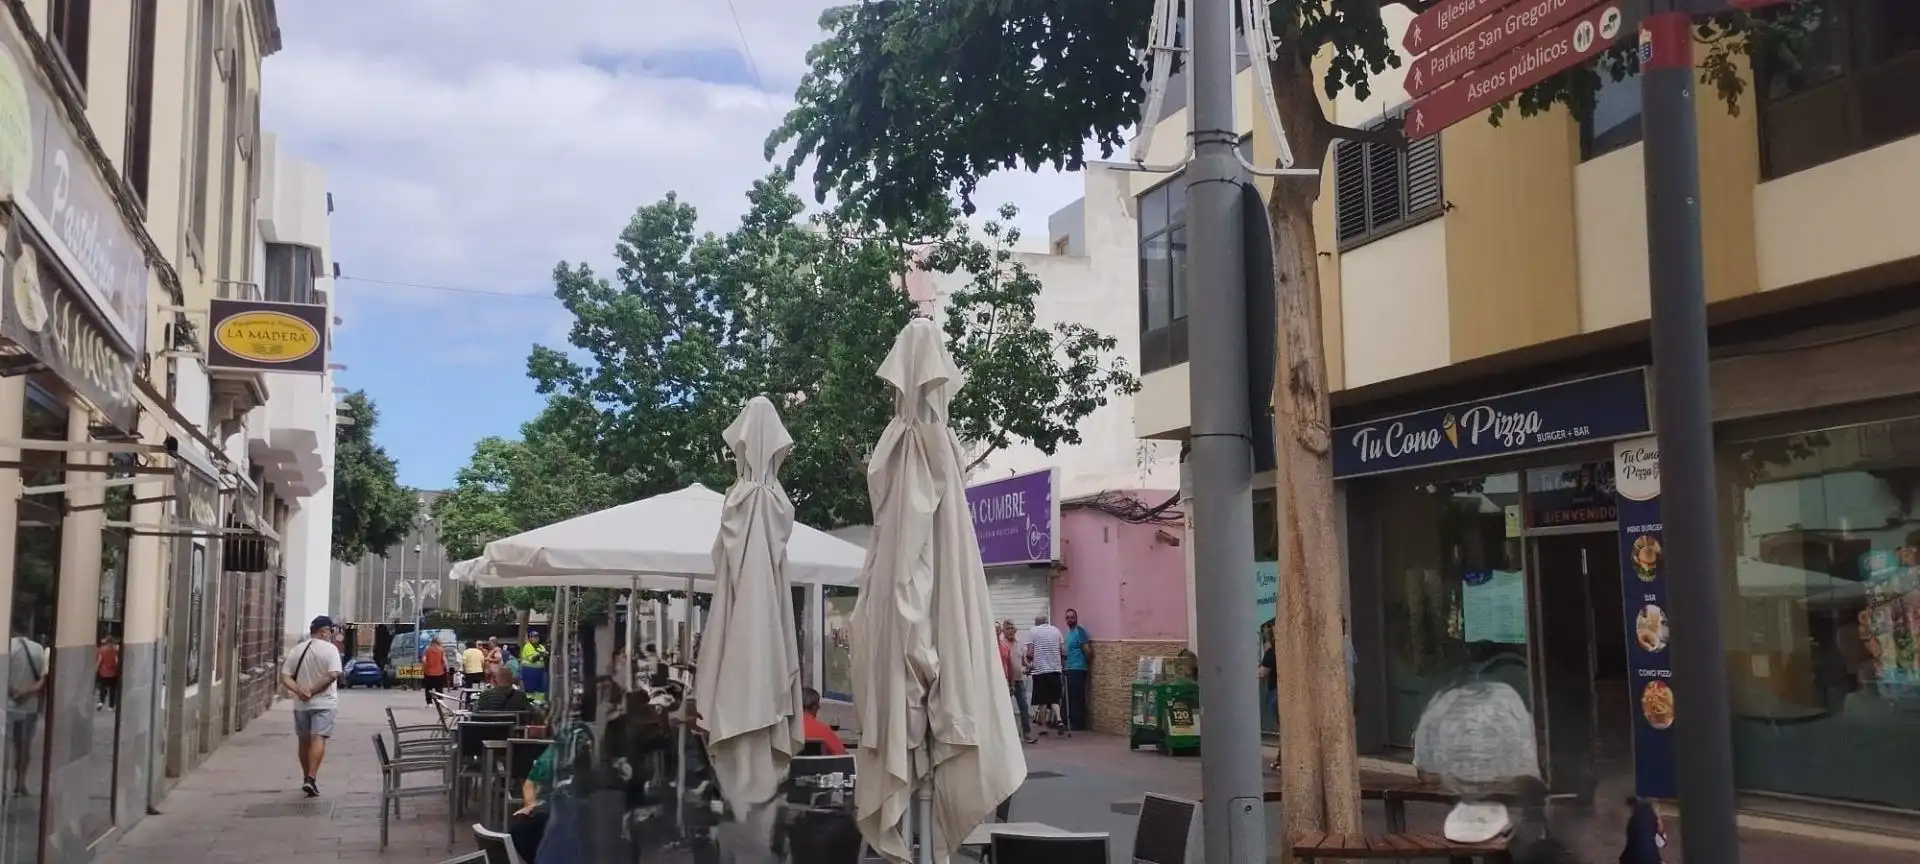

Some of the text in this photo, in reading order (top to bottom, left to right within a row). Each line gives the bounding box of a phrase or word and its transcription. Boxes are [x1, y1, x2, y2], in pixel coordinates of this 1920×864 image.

[1438, 0, 1476, 30] Iglesia
[1430, 41, 1476, 76] Parking
[1478, 27, 1501, 50] San
[1467, 38, 1568, 102] Aseos públicos
[227, 328, 308, 343] LA MADERA
[1352, 405, 1543, 462] Tu Cono Pizza
[1536, 429, 1567, 443] BURGER
[1574, 425, 1590, 437] BAR
[1620, 450, 1634, 464] Tu
[1623, 465, 1652, 480] Pizza
[979, 490, 1027, 524] CUMBRE
[1173, 710, 1190, 720] 120
